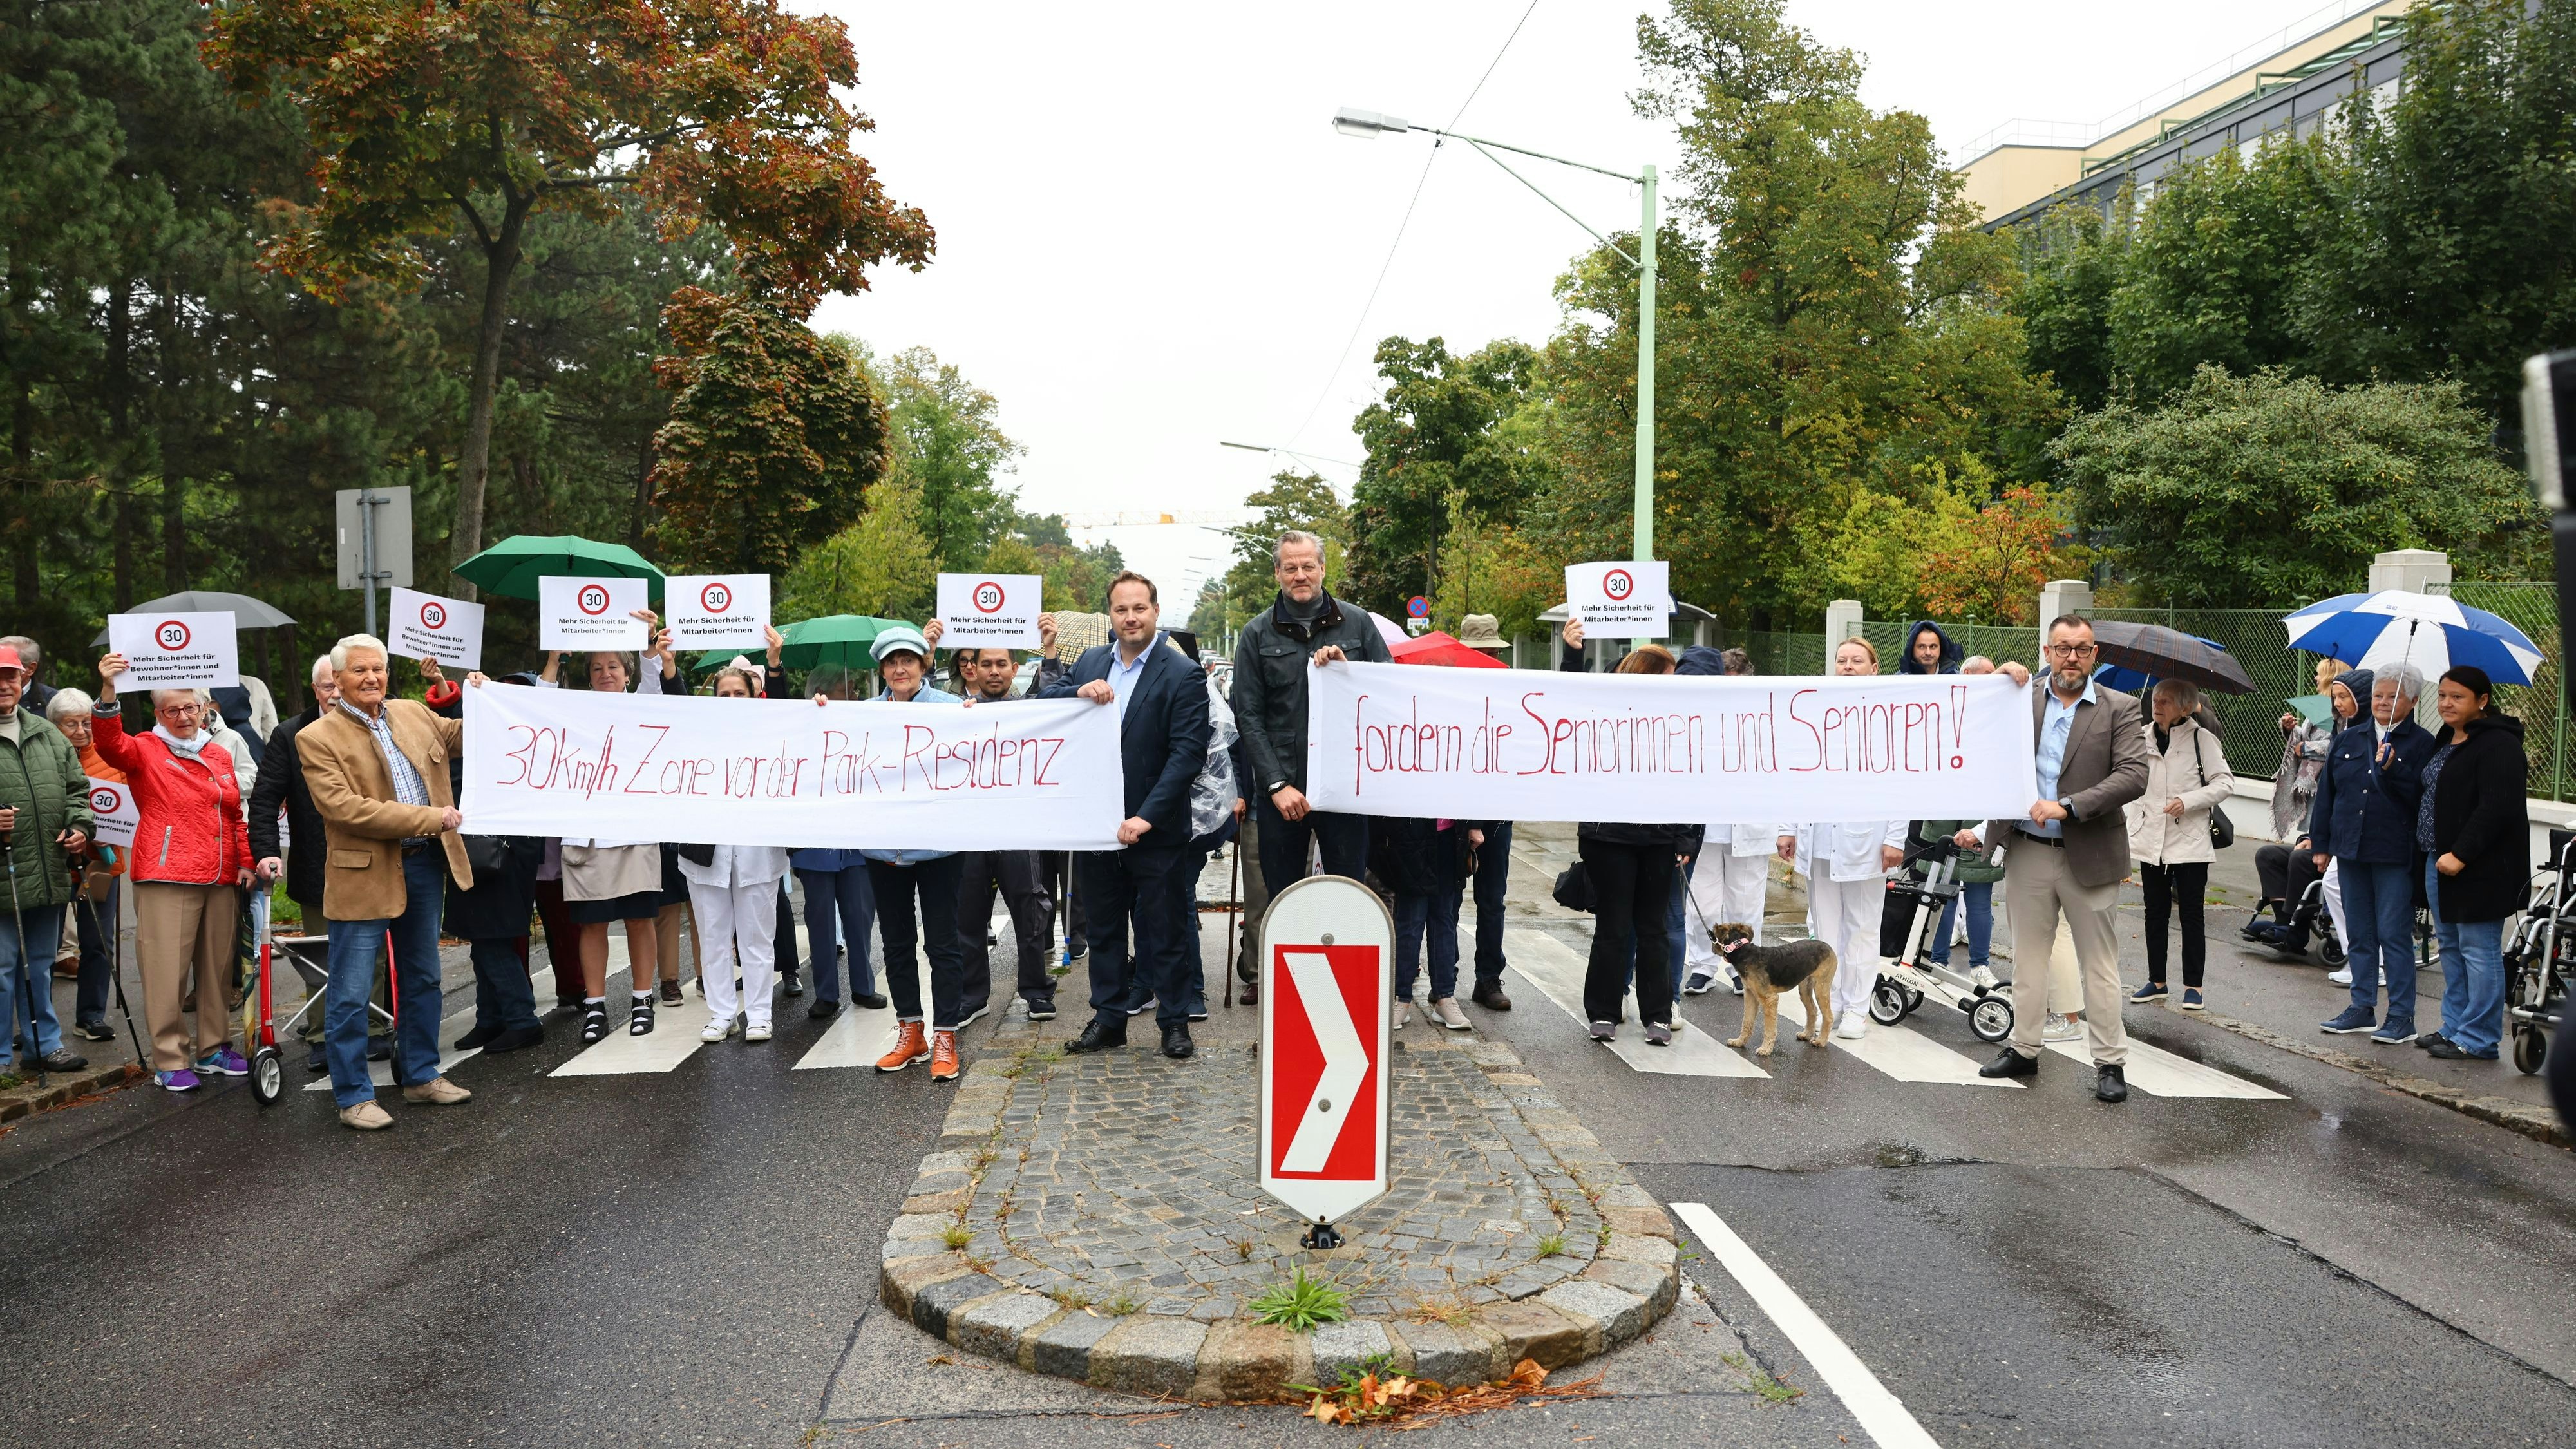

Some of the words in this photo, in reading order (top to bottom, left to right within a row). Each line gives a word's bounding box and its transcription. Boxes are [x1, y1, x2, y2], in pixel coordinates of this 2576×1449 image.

[1611, 578, 1625, 591] 30
[586, 594, 601, 606] 30
[708, 592, 724, 604] 30
[981, 591, 996, 603] 30
[426, 610, 439, 621] 30
[164, 629, 182, 642] 30
[419, 630, 451, 641] Sicherheit
[1355, 695, 1461, 796] fordern
[1472, 696, 1512, 773] die
[1517, 692, 1703, 775] Seniorinnen
[1722, 692, 1778, 773] und
[1790, 685, 1967, 773] Senioren!
[624, 724, 715, 795] Zone
[821, 721, 1065, 797] Park-Residenz
[95, 794, 113, 807] 30
[1895, 973, 1918, 987] ATHLON
